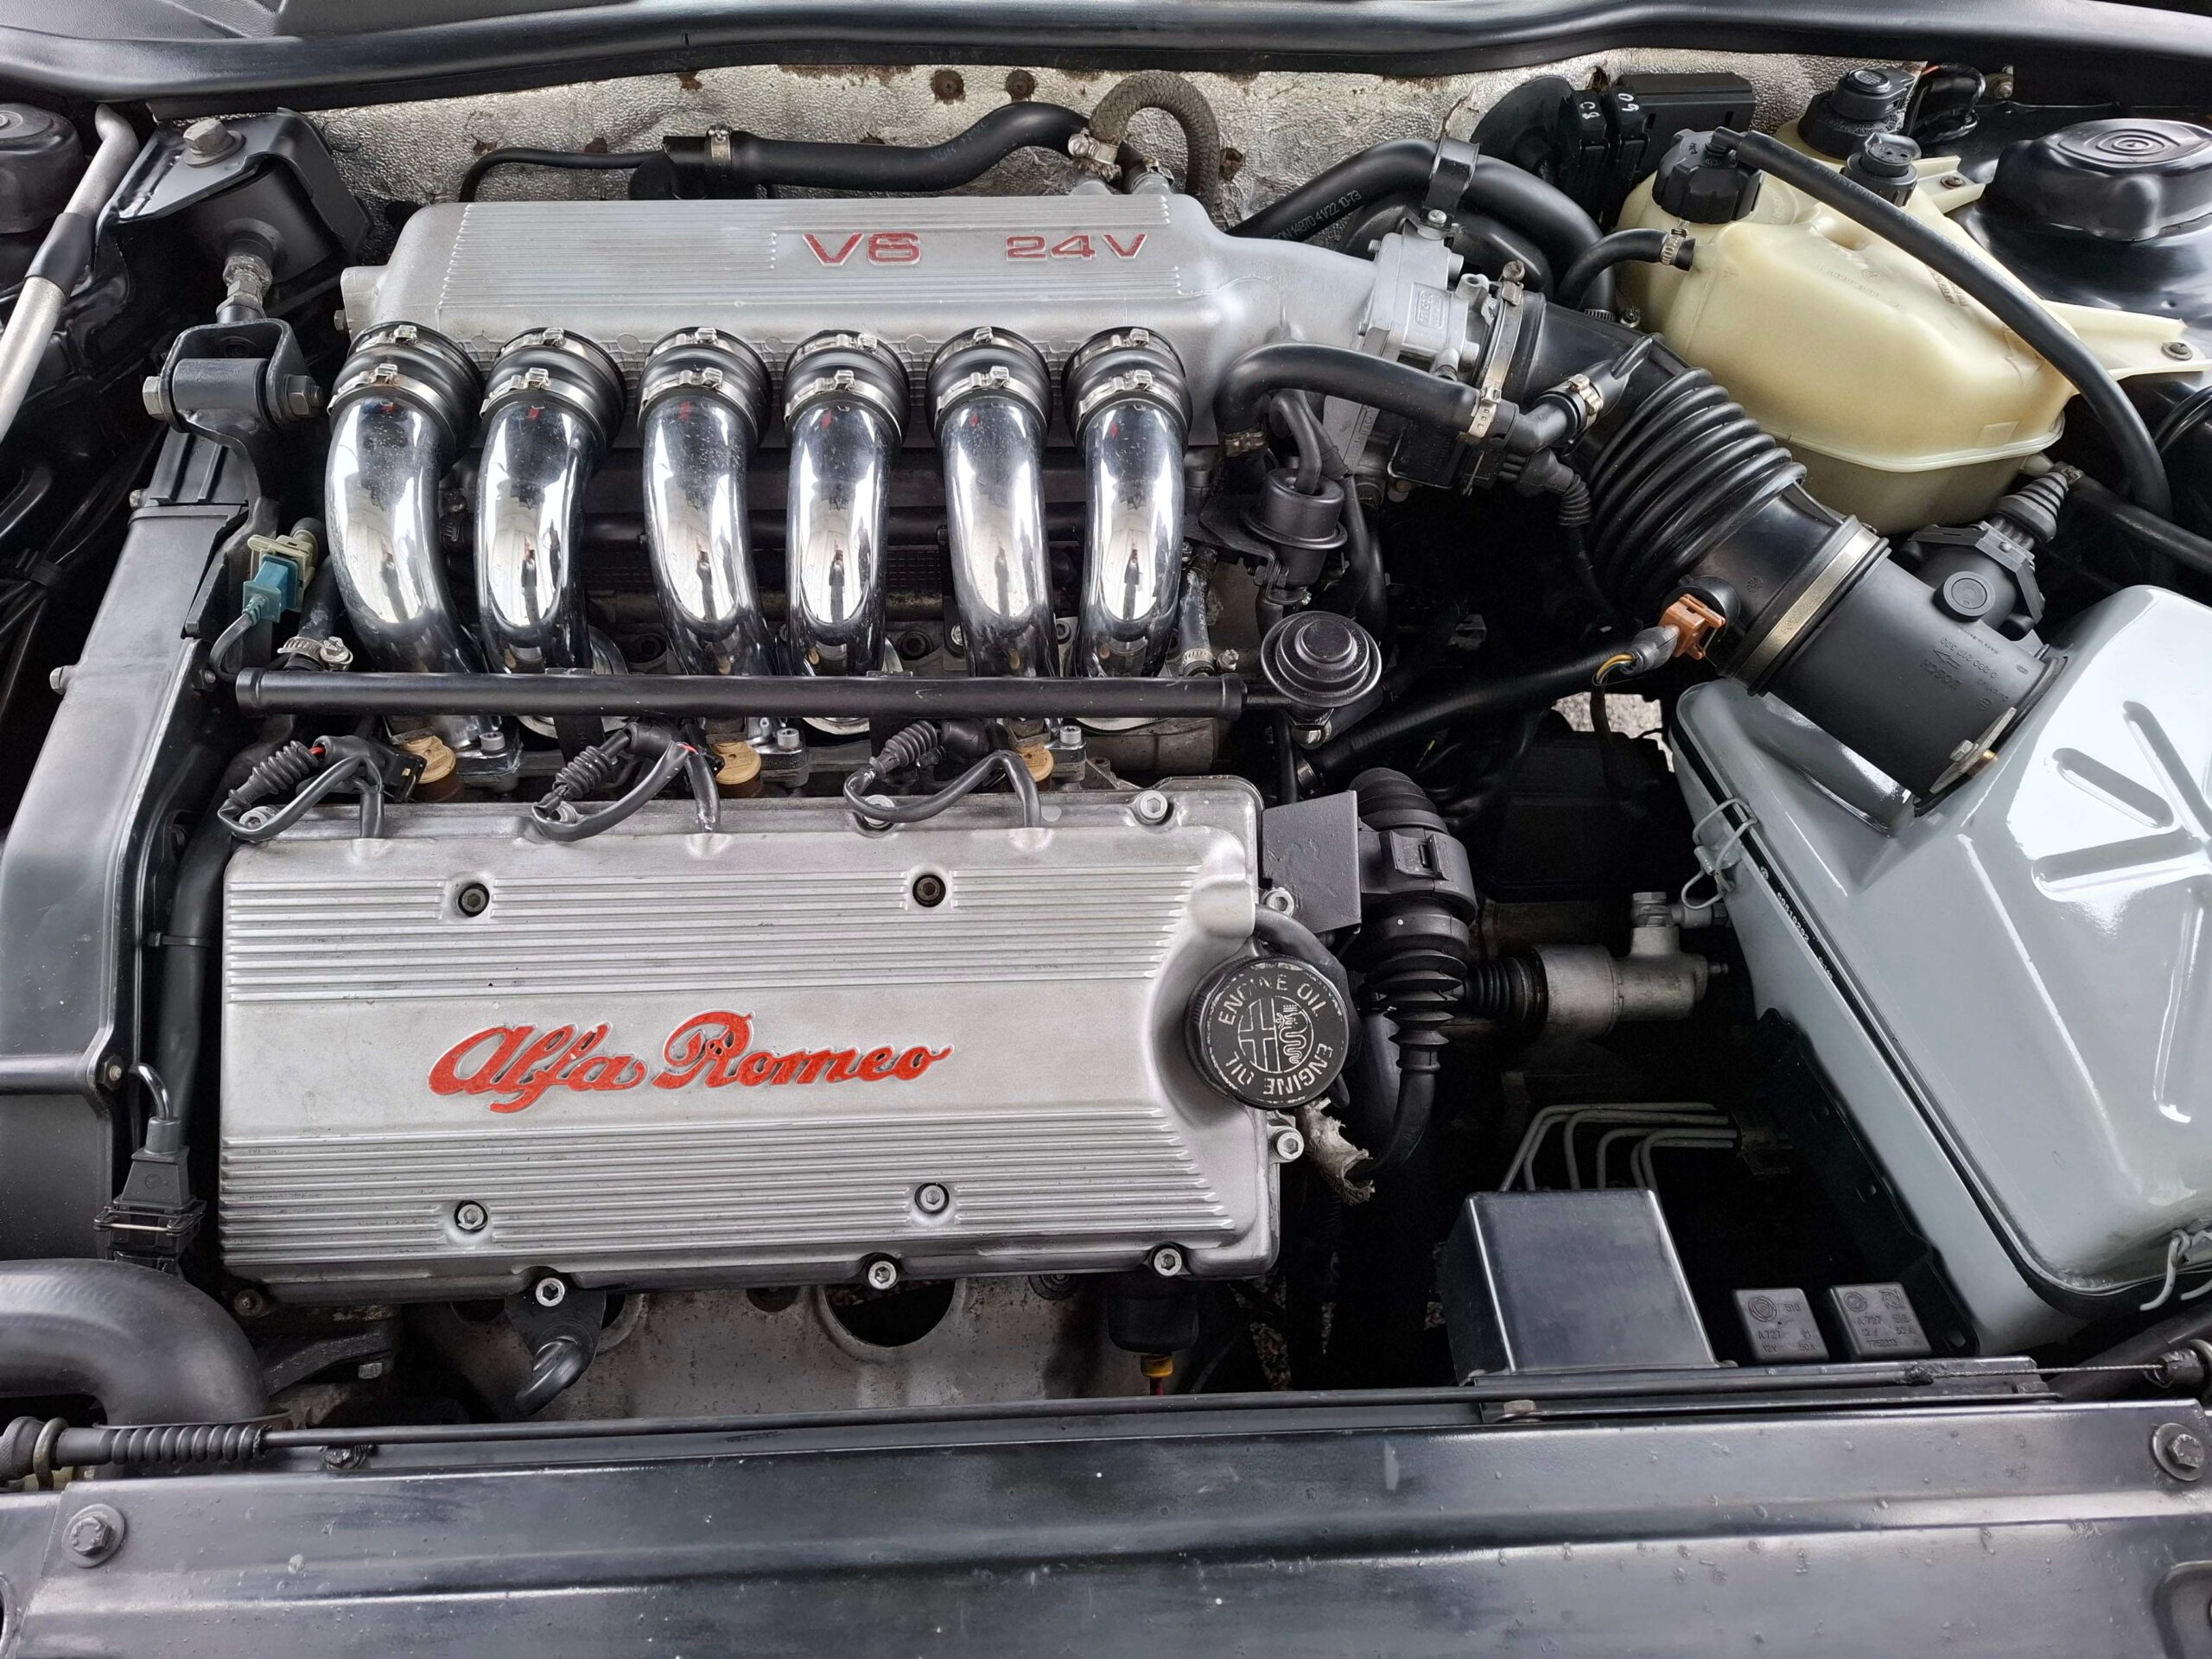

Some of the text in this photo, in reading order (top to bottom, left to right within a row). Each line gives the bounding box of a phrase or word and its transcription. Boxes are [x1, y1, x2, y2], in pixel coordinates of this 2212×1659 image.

[802, 232, 1148, 266] V6 24V
[1296, 982, 1327, 1018] OIL
[428, 1009, 955, 1113] Alfa Romeo
[1262, 1042, 1334, 1096] ENGINE
